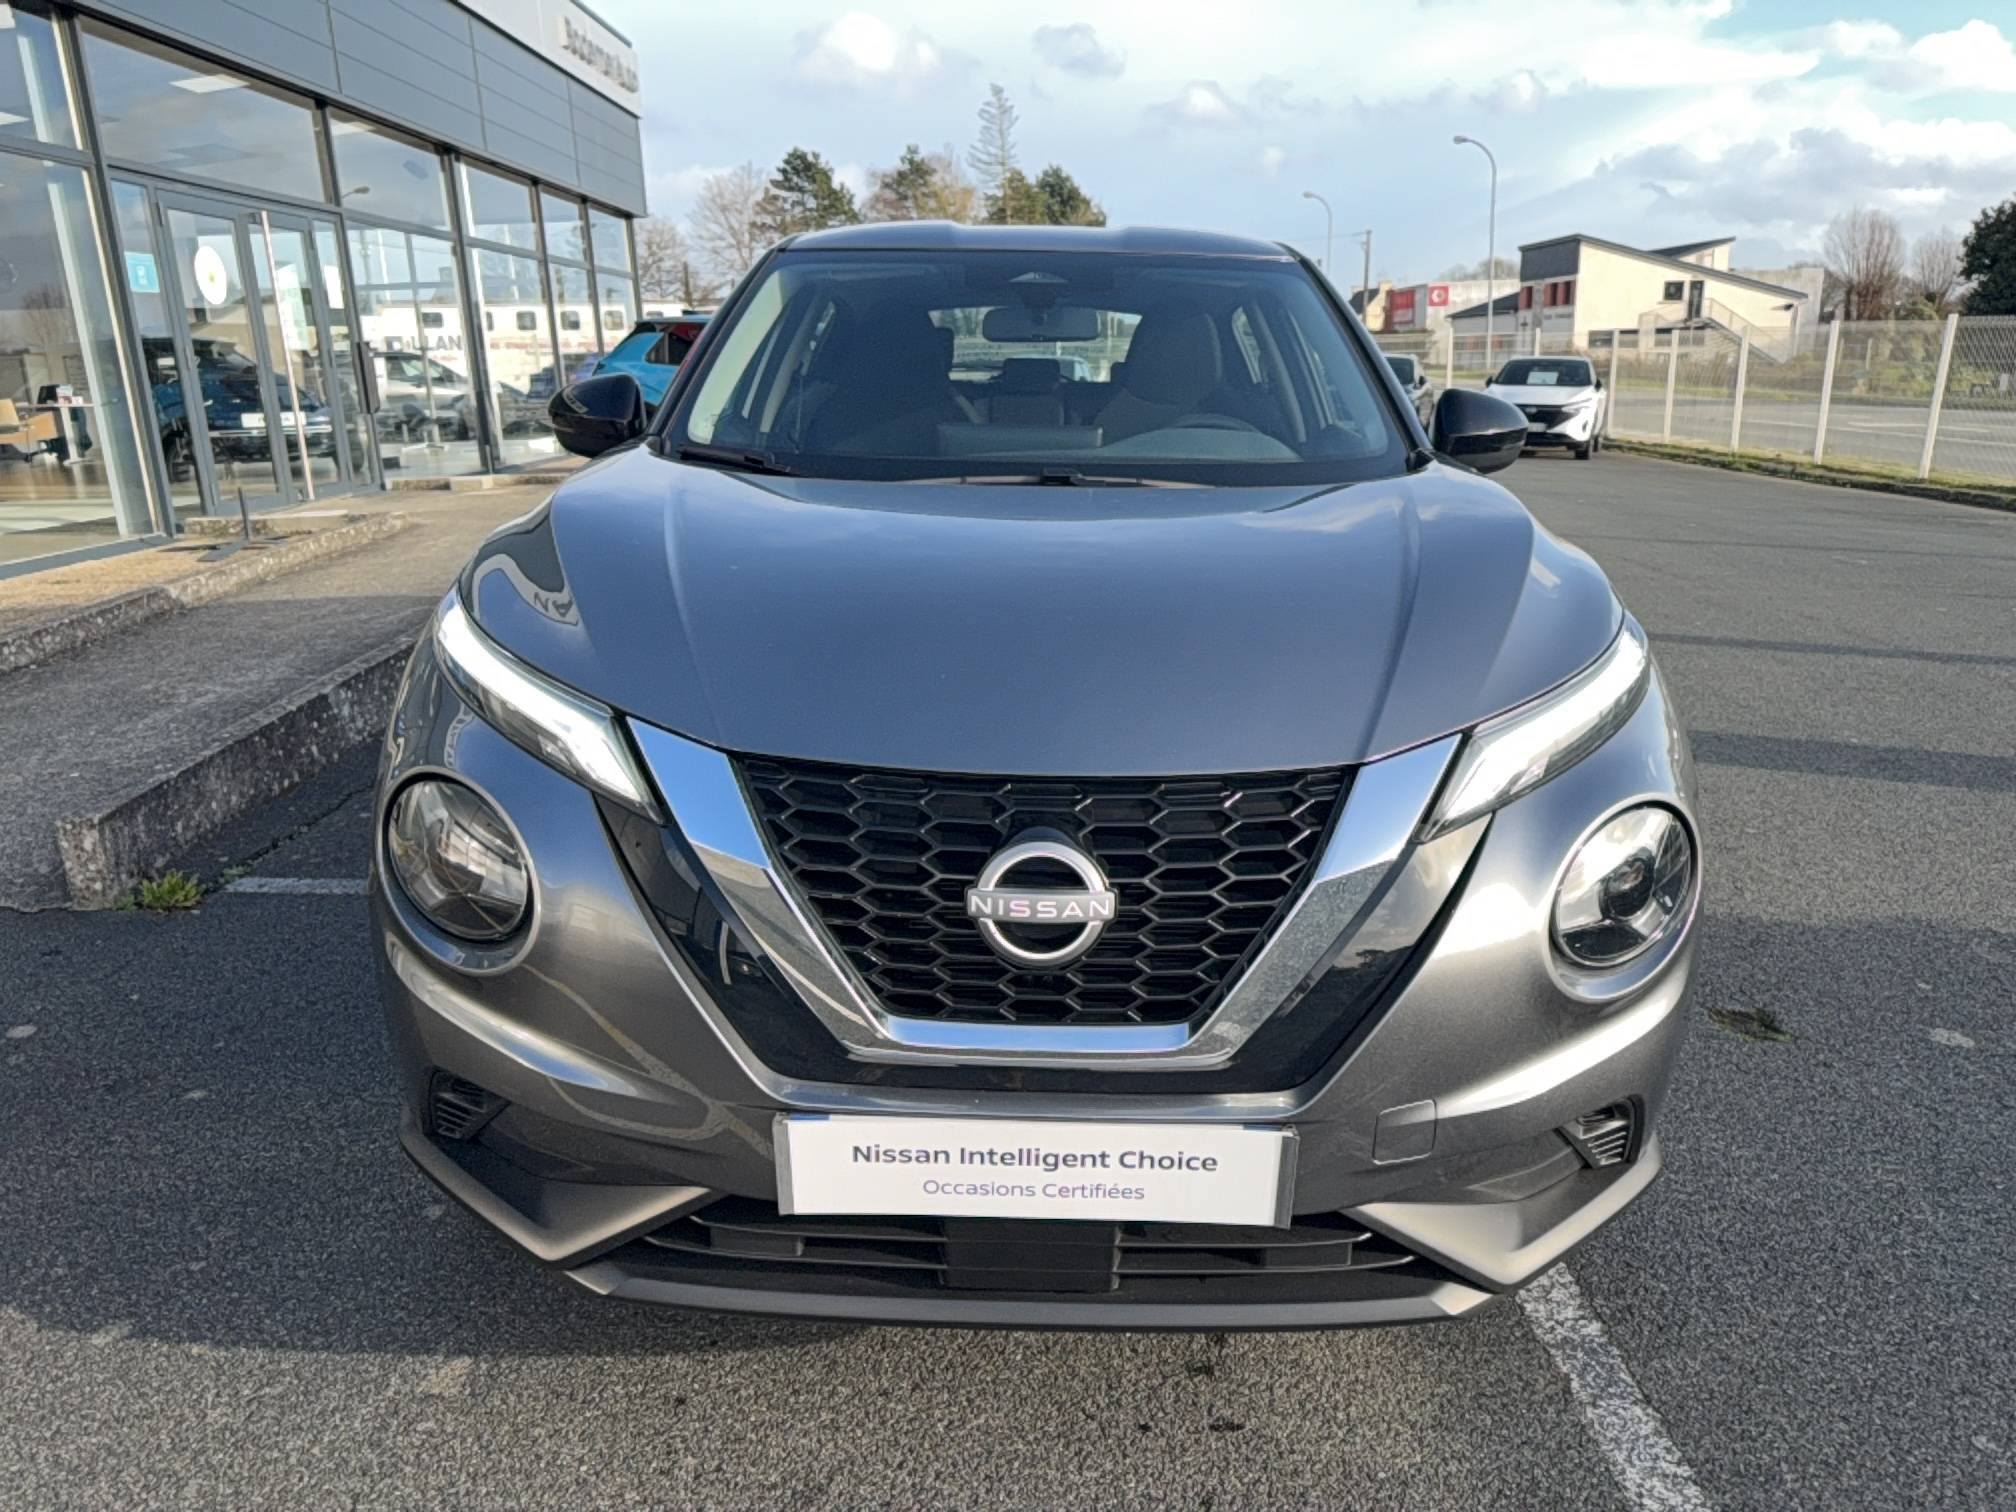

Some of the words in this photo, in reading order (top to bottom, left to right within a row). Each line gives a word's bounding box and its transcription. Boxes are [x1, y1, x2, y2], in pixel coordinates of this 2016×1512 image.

[970, 895, 1110, 918] NISSAN
[853, 1144, 950, 1164] Nissan
[960, 1148, 1110, 1172] Intelligent
[1119, 1150, 1218, 1171] Choice
[923, 1180, 1036, 1196] Occasions
[1042, 1184, 1144, 1199] Certifiées
